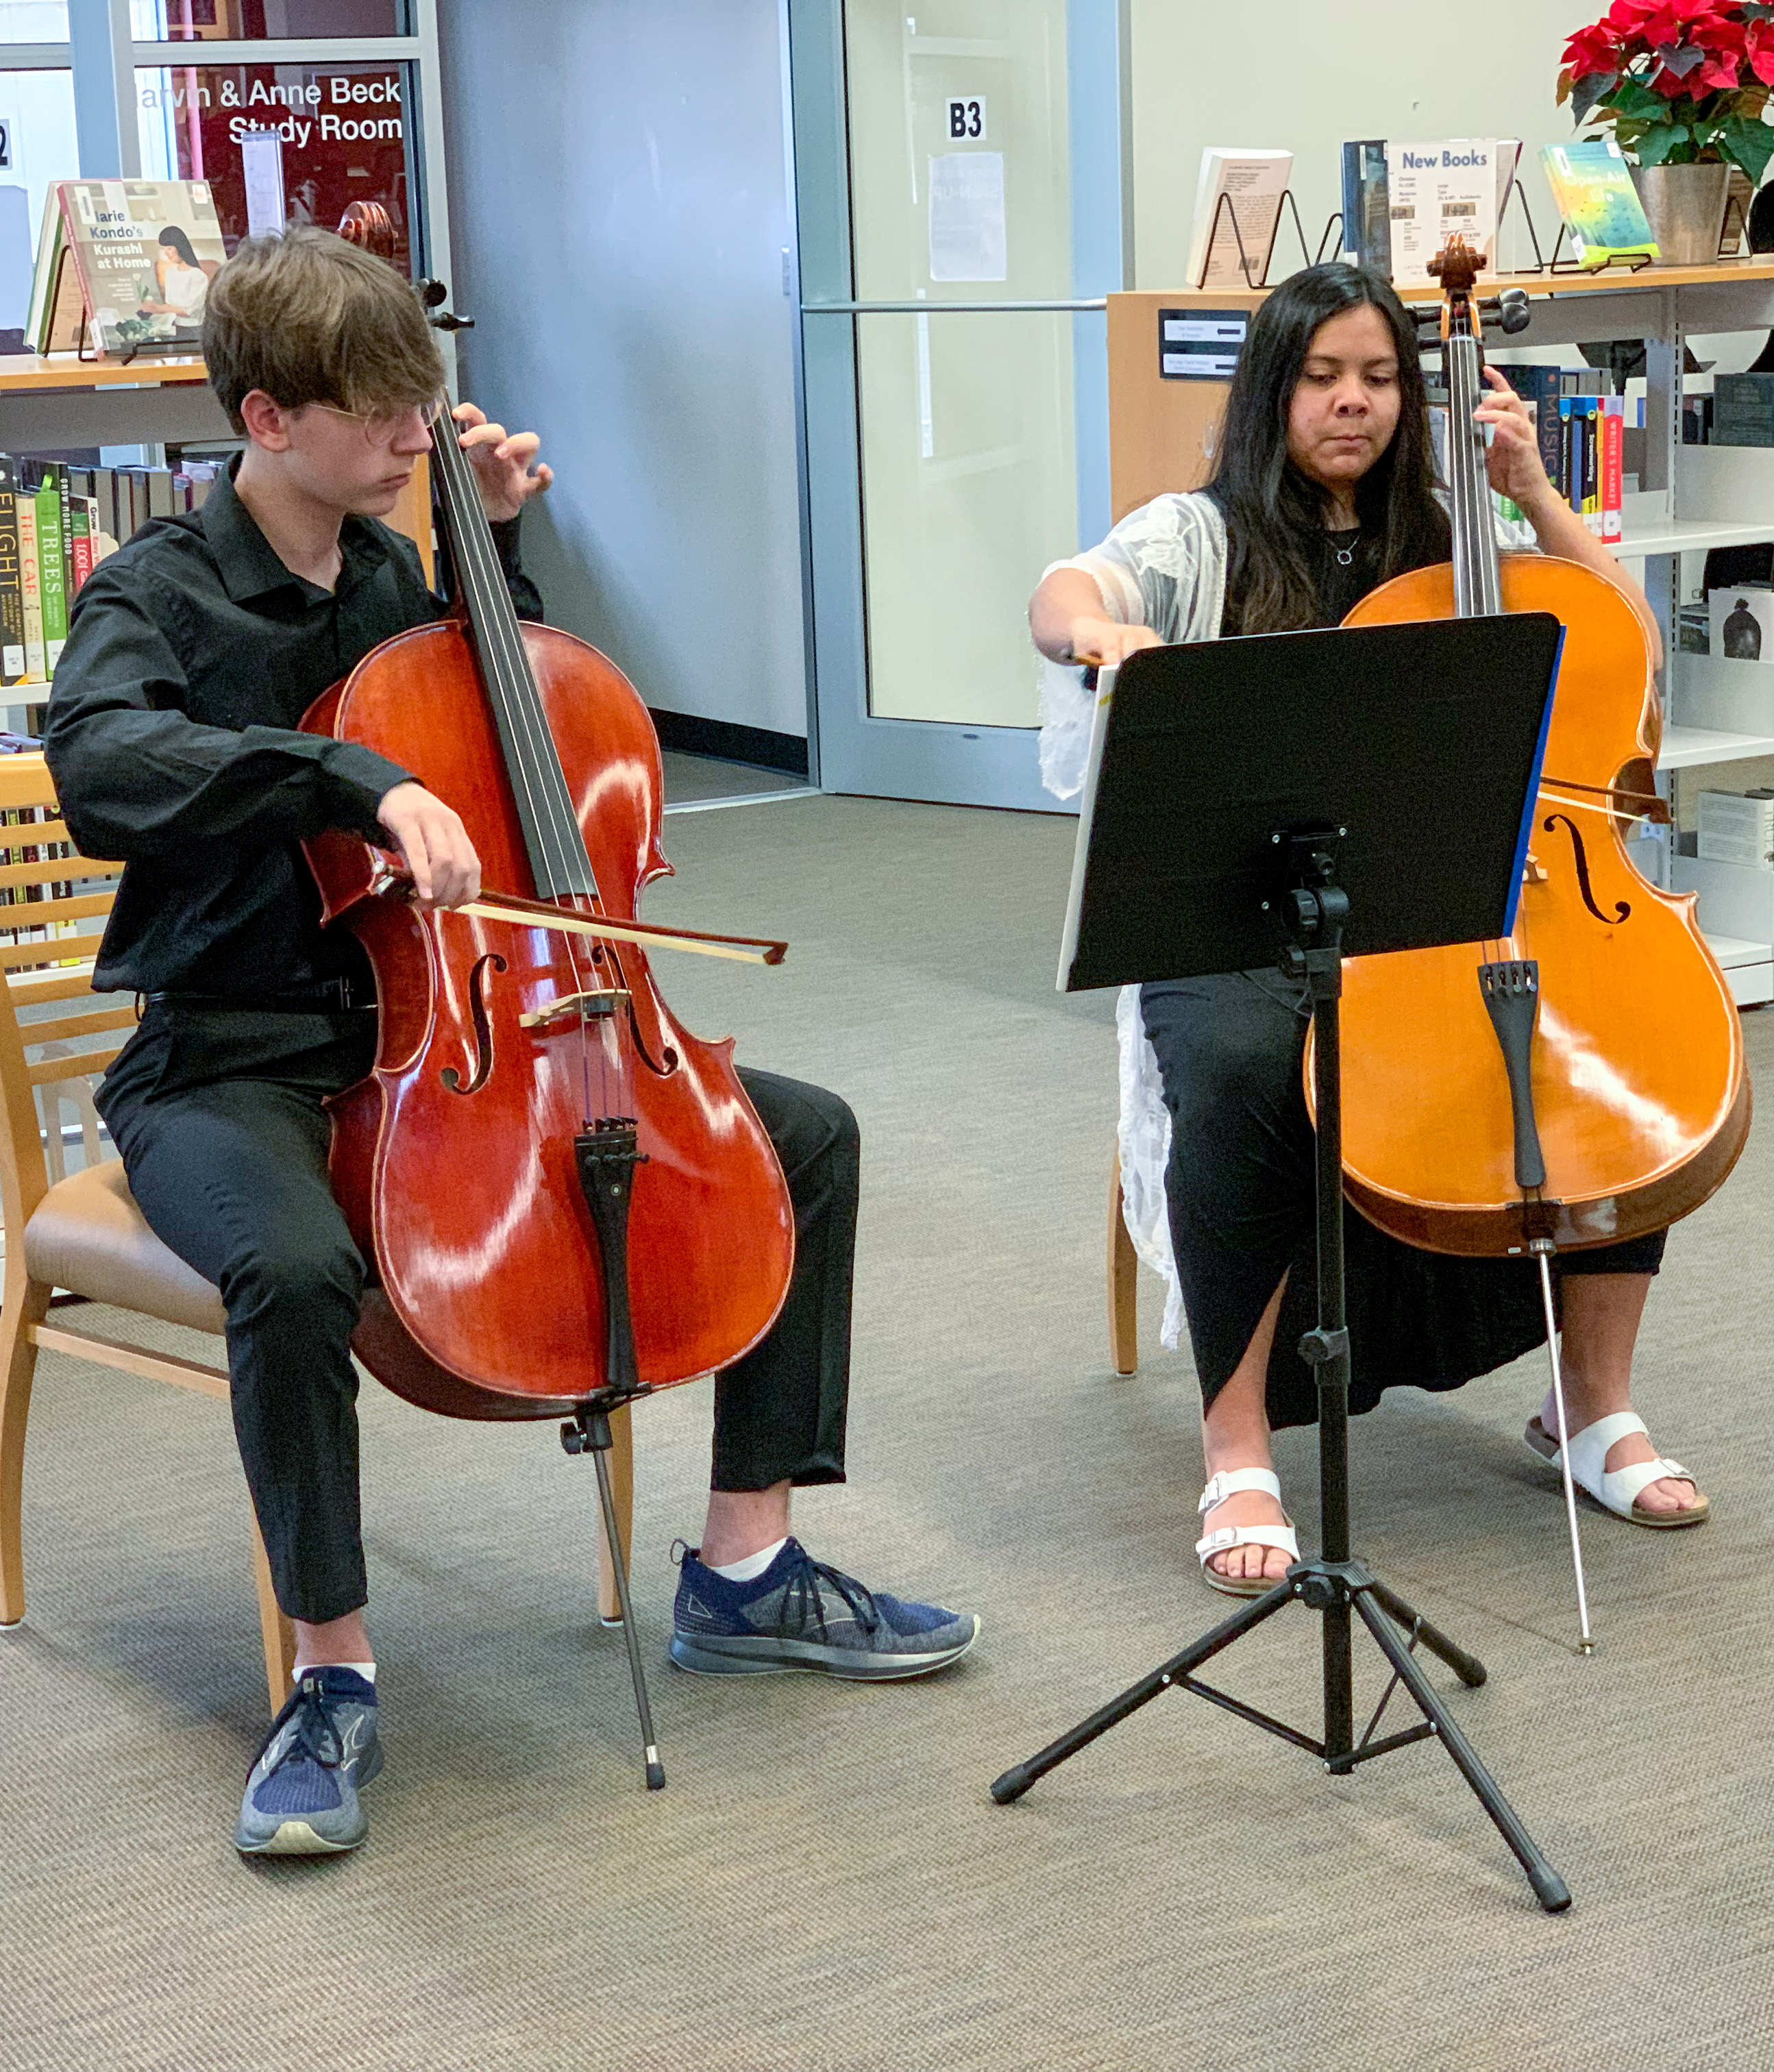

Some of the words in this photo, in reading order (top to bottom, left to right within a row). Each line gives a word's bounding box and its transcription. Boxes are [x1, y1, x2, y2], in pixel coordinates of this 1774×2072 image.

[138, 82, 210, 108] arvin
[220, 80, 241, 107] &
[249, 79, 322, 106] Anne
[331, 76, 402, 104] Beck
[229, 115, 312, 148] Study
[321, 114, 403, 141] Room
[950, 101, 982, 138] B3
[1403, 151, 1438, 169] New
[1442, 149, 1488, 167] Books
[90, 225, 144, 239] Kondo's
[93, 242, 143, 256] Kurashi
[97, 260, 112, 269] at
[113, 257, 151, 269] Home
[1544, 394, 1558, 471] MUSIC
[60, 478, 69, 502] GROW
[62, 506, 71, 530] MORE
[21, 515, 34, 548] THE
[64, 532, 73, 555] FOOD
[41, 520, 62, 594] TREES
[75, 543, 88, 569] 1,001
[24, 558, 37, 595] CAR
